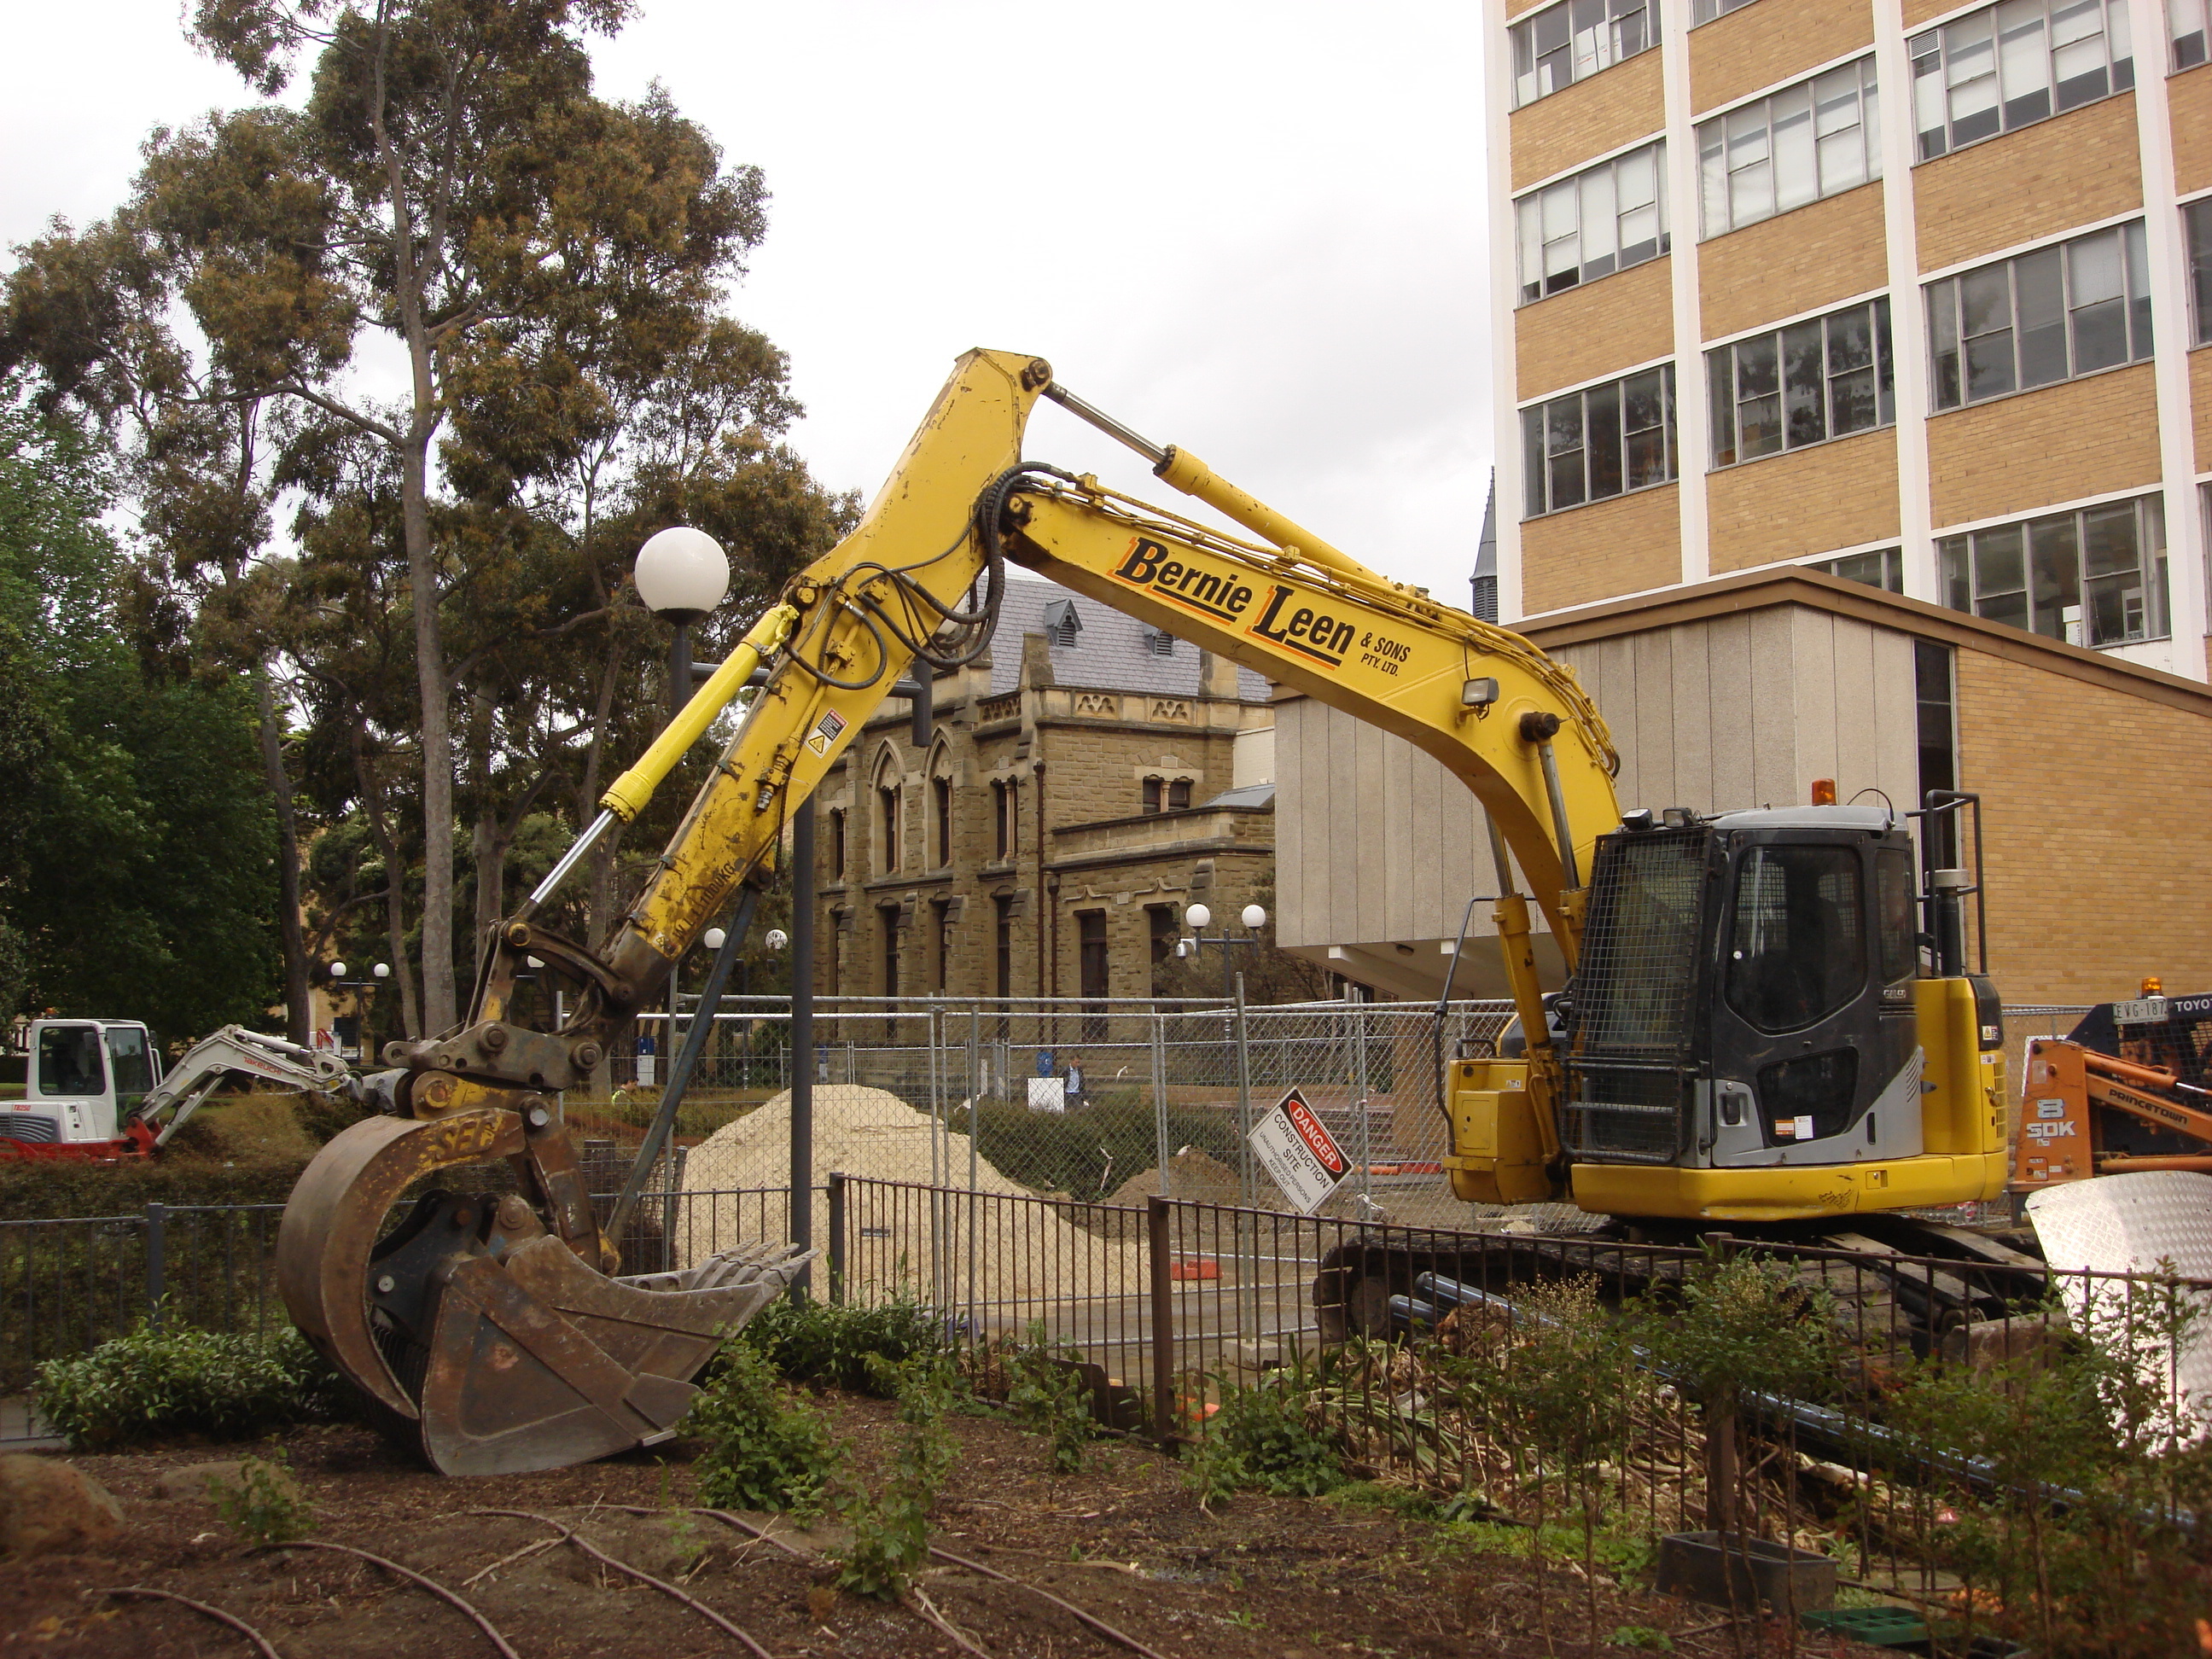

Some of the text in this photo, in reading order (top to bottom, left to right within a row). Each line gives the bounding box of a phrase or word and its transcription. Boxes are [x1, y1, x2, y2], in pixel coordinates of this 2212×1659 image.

[1113, 536, 1412, 663] Bernie Leen & SONS
[1360, 653, 1399, 677] PTY. LTD.
[2037, 1098, 2064, 1118] 8
[2109, 1088, 2187, 1125] PRINCETOWN
[1293, 1106, 1336, 1166] DANGER
[2026, 1121, 2076, 1138] SDK
[1259, 1131, 1312, 1203] UNAUTHORISED PERSONS
[1274, 1114, 1330, 1189] CONSTRUCTION
[1283, 1149, 1301, 1173] SITE
[1267, 1158, 1290, 1187] KEEP OUT
